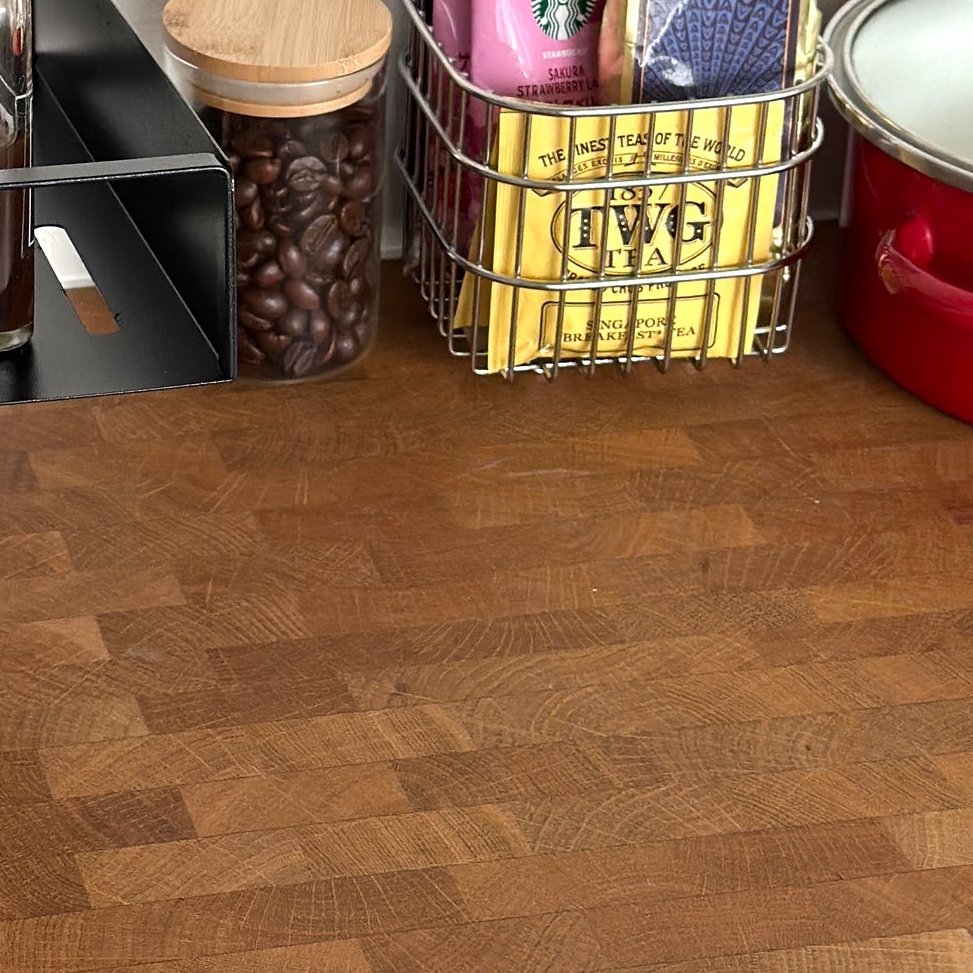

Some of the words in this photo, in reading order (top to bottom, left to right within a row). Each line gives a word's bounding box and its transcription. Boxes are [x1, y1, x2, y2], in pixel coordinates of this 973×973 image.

[548, 65, 584, 81] SAKURA
[517, 79, 583, 97] STRAWBERRY
[538, 148, 566, 167] THE
[572, 137, 611, 156] INES
[655, 133, 672, 145] OF
[571, 201, 712, 248] TWG
[586, 316, 676, 331] SNGPOR
[670, 326, 695, 337] EA
